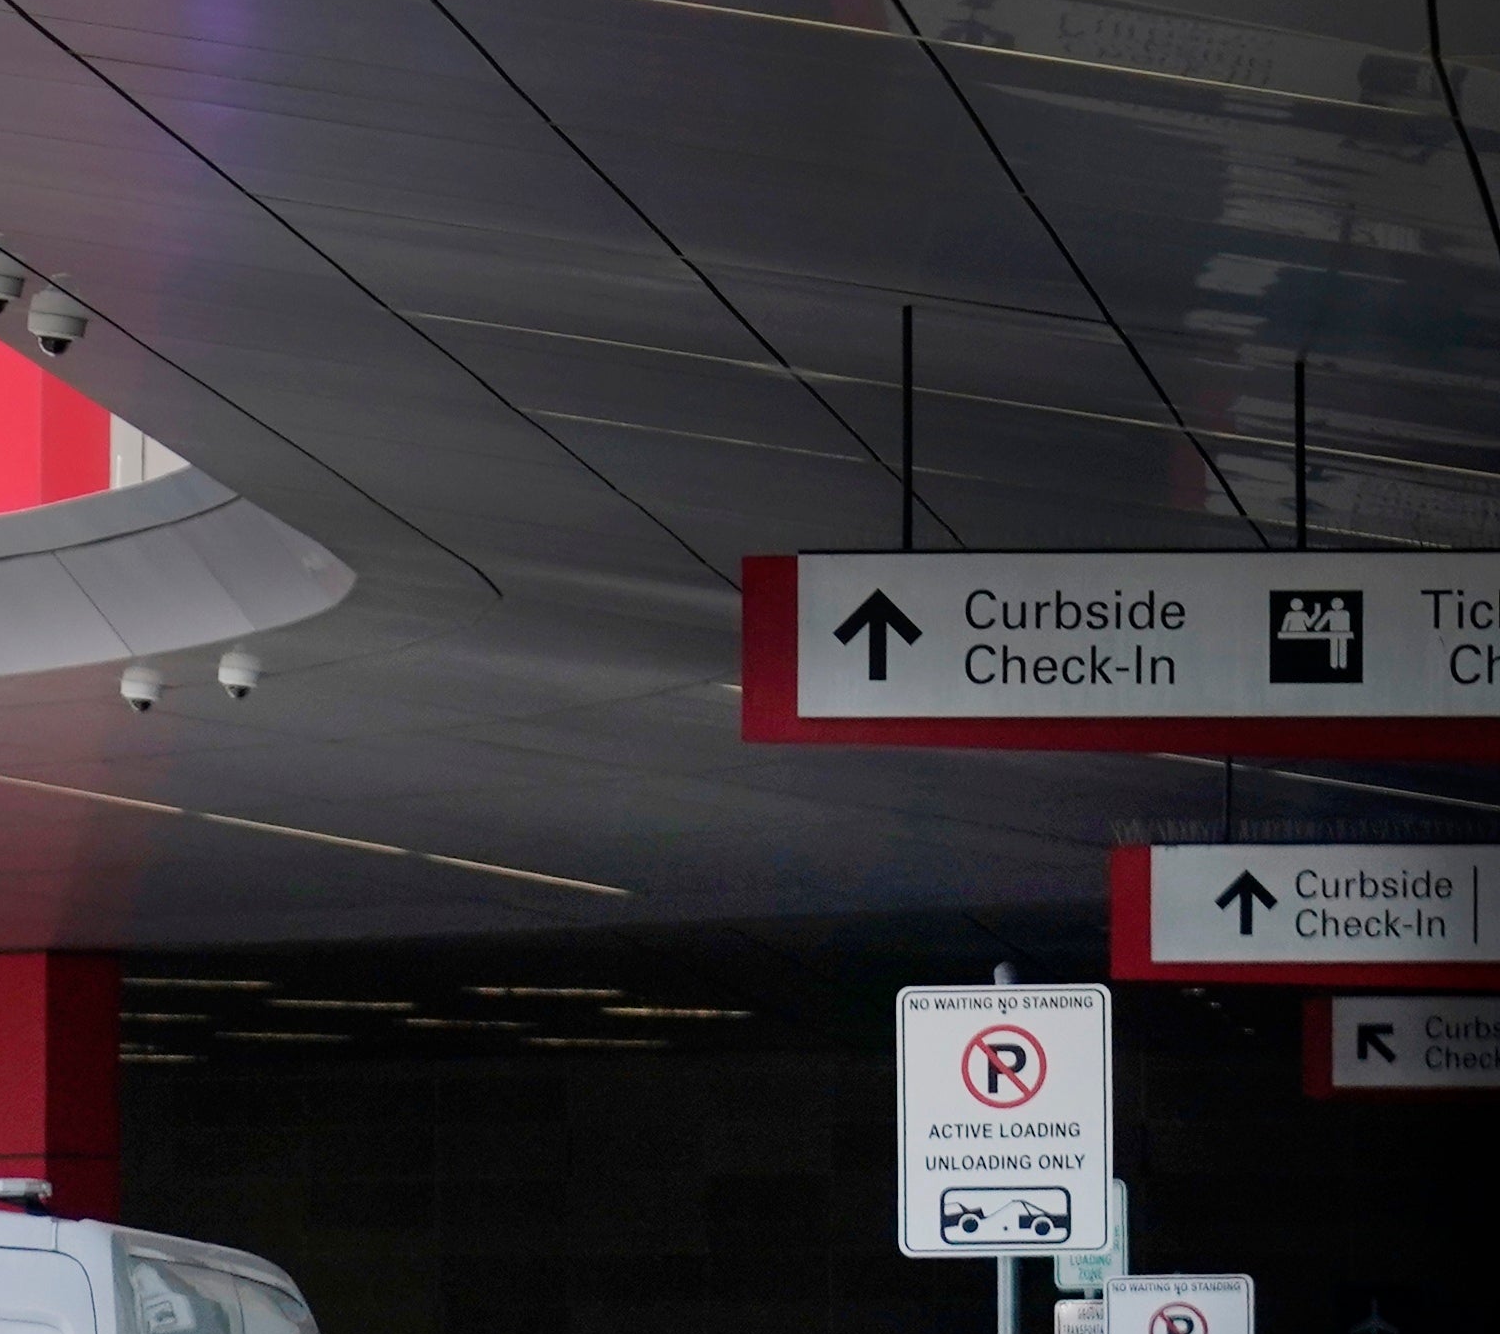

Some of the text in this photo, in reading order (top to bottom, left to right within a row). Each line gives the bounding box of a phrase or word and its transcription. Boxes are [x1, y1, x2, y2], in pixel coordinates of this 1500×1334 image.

[965, 589, 1186, 632] Curbside
[1421, 589, 1500, 630] Tic
[965, 644, 1177, 686] Check-In
[1294, 870, 1453, 900] Curbside
[1294, 909, 1447, 939] Check-In
[910, 995, 1093, 1010] NO WAITING NO STANDING
[928, 1122, 1081, 1139] ACTIVE LOADING
[925, 1154, 1086, 1171] UNLOADING ONLY
[1112, 1281, 1241, 1292] NO WAITING NO STANDING
